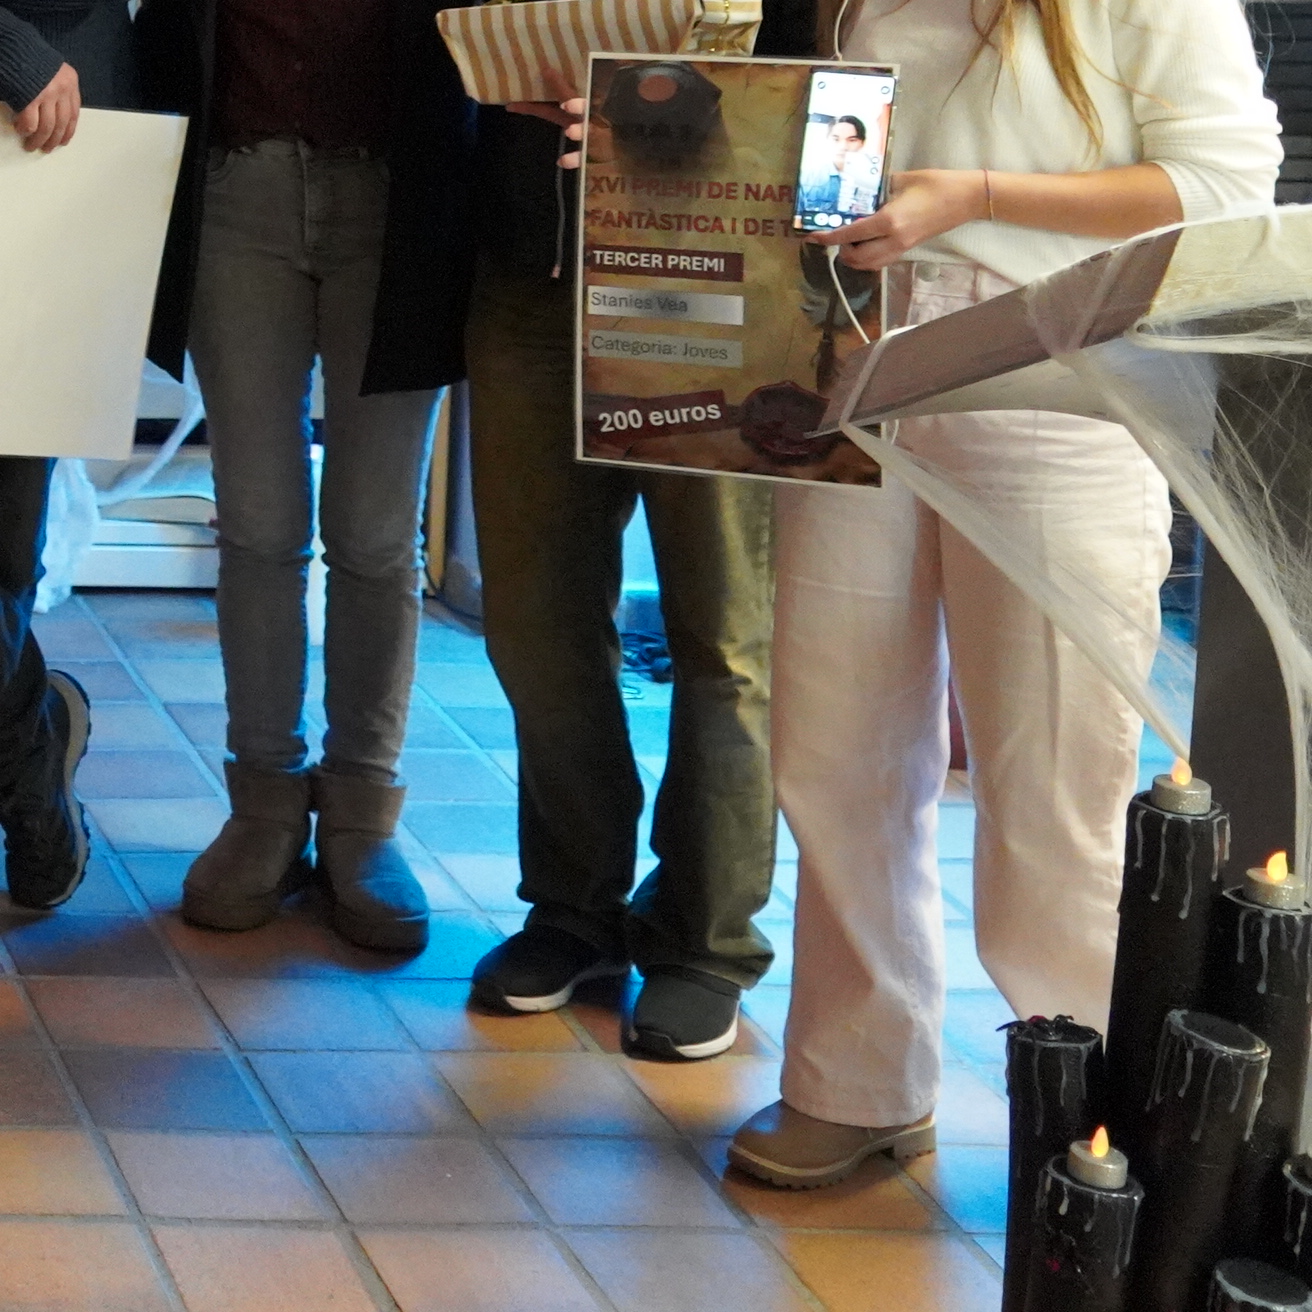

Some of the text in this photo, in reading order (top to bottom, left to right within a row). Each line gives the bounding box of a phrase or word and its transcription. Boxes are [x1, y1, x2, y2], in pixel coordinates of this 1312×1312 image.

[590, 175, 626, 194] XVI
[631, 177, 702, 199] PREMI
[707, 181, 739, 200] DE
[589, 208, 725, 234] FANTÀSTICA
[730, 217, 737, 235] I
[743, 217, 775, 237] DE
[593, 250, 726, 273] TERCER PREMI
[591, 335, 729, 361] Categoria: Joves
[598, 401, 722, 433] 200 euros
